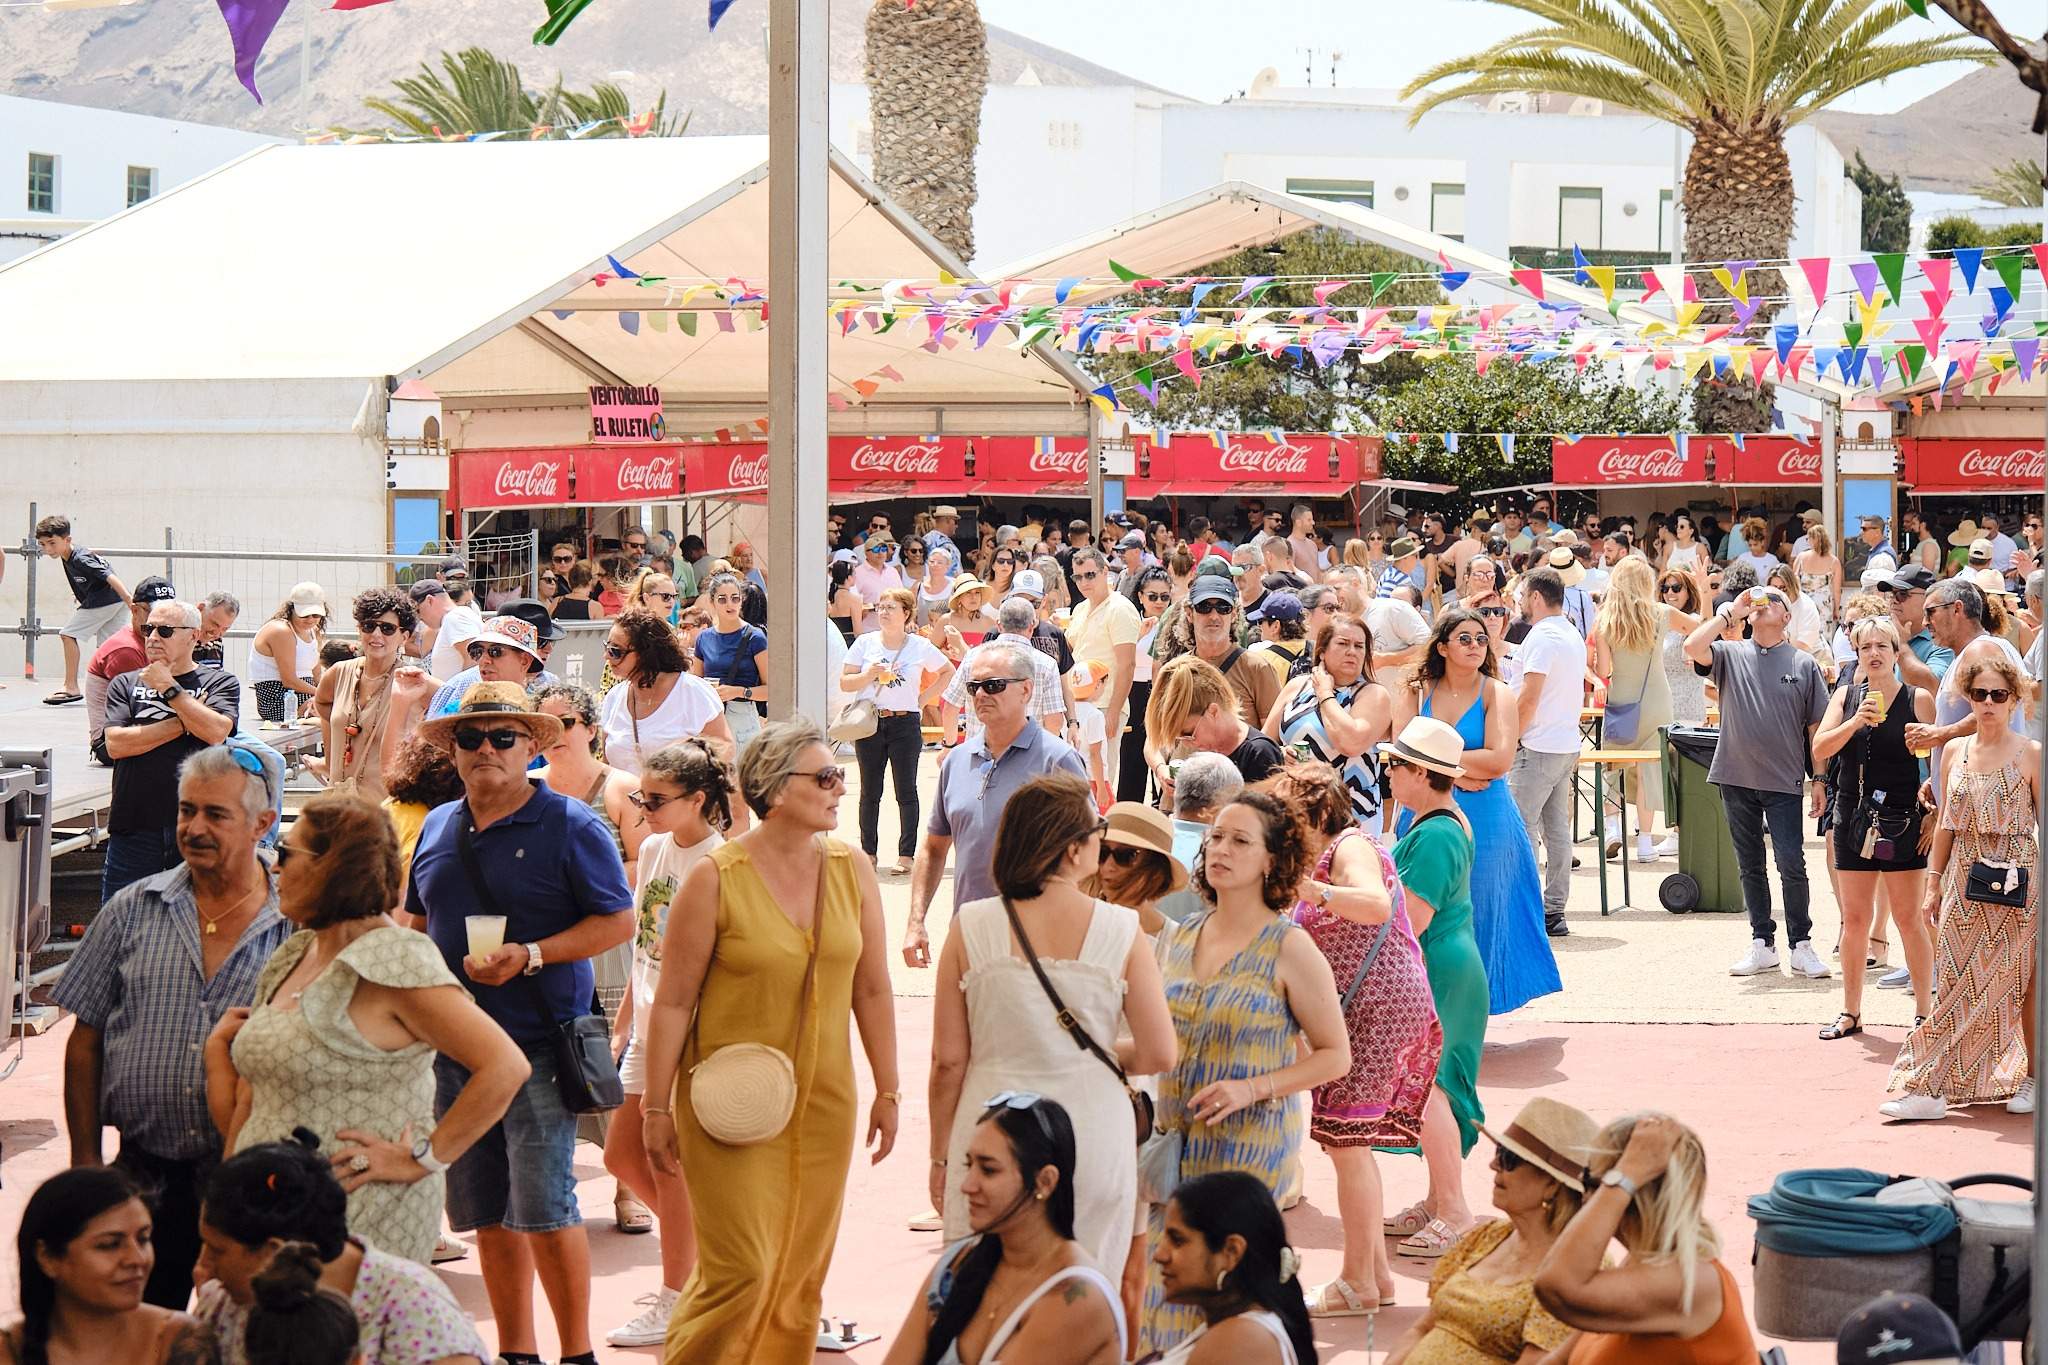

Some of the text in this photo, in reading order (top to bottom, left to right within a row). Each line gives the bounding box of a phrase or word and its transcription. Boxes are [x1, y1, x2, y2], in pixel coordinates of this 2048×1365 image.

[590, 386, 659, 405] VENTORRILLO
[593, 417, 650, 437] EL RULETA
[728, 454, 768, 486] Coca-Co
[851, 445, 943, 473] Coca-Cola
[1030, 448, 1088, 473] Coca-C
[1219, 443, 1312, 473] Coca-Cola
[1598, 448, 1684, 477] Coca-Cola
[1959, 448, 2045, 477] Coca-Cola
[495, 462, 560, 496] Coca-Cola
[617, 457, 675, 491] Coca-Cola
